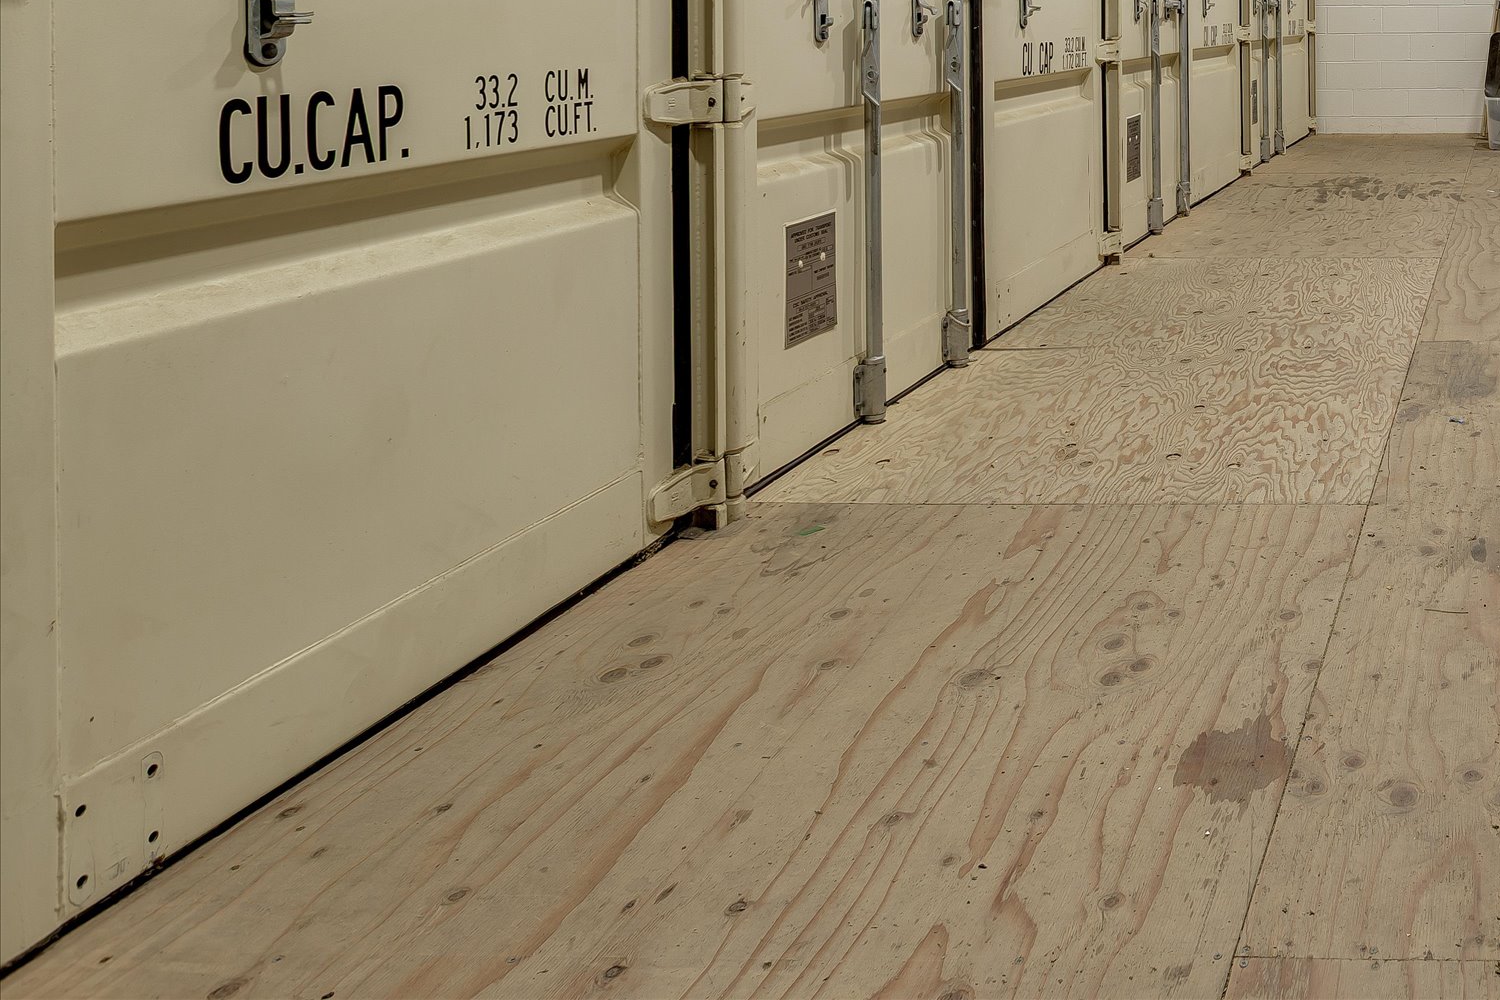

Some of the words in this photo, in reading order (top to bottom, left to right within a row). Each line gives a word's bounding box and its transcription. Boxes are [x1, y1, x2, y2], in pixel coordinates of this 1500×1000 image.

[474, 73, 518, 111] 33.2
[218, 84, 410, 185] CU.CAP.
[463, 109, 519, 150] 1,173
[544, 101, 598, 138] CU.FT.
